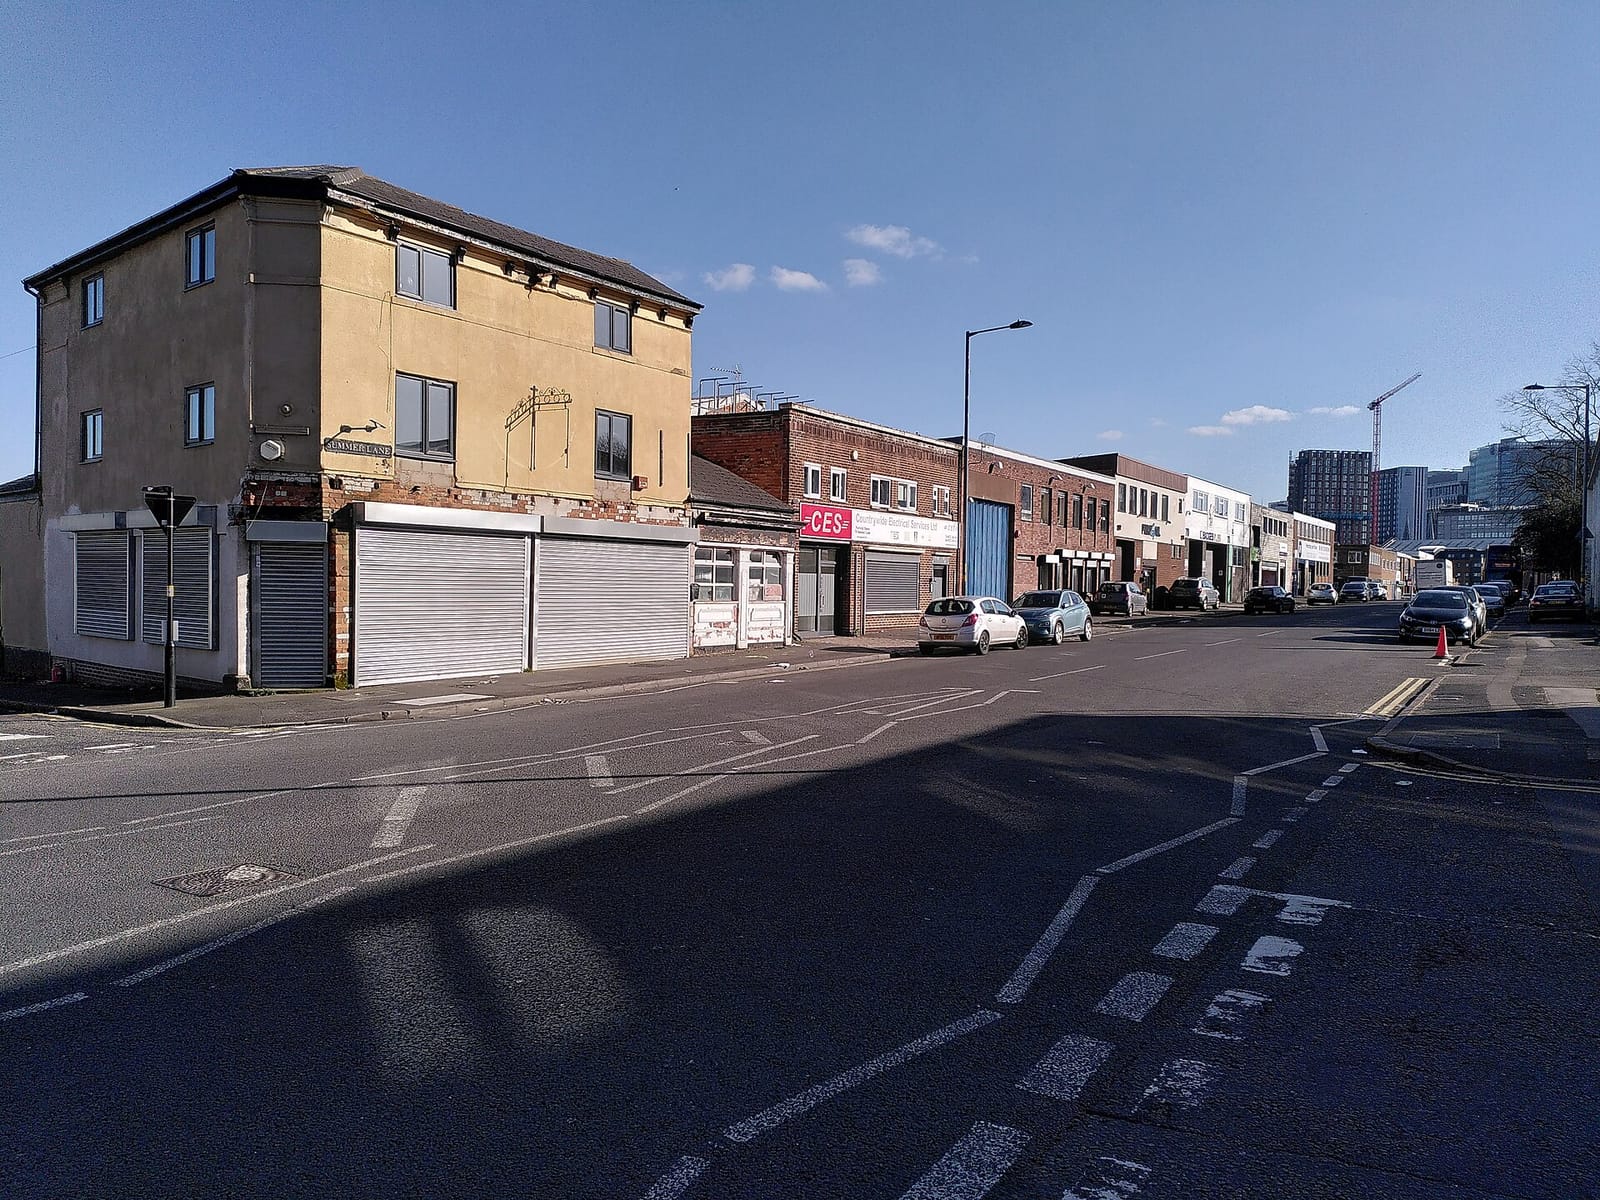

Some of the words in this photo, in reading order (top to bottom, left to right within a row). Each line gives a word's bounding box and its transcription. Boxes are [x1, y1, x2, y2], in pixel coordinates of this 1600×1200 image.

[326, 440, 365, 452] SUMMER
[366, 445, 391, 456] LANE
[811, 510, 843, 534] CES
[855, 513, 888, 526] Countrywide
[888, 516, 910, 528] Electrical
[910, 520, 930, 530] Services
